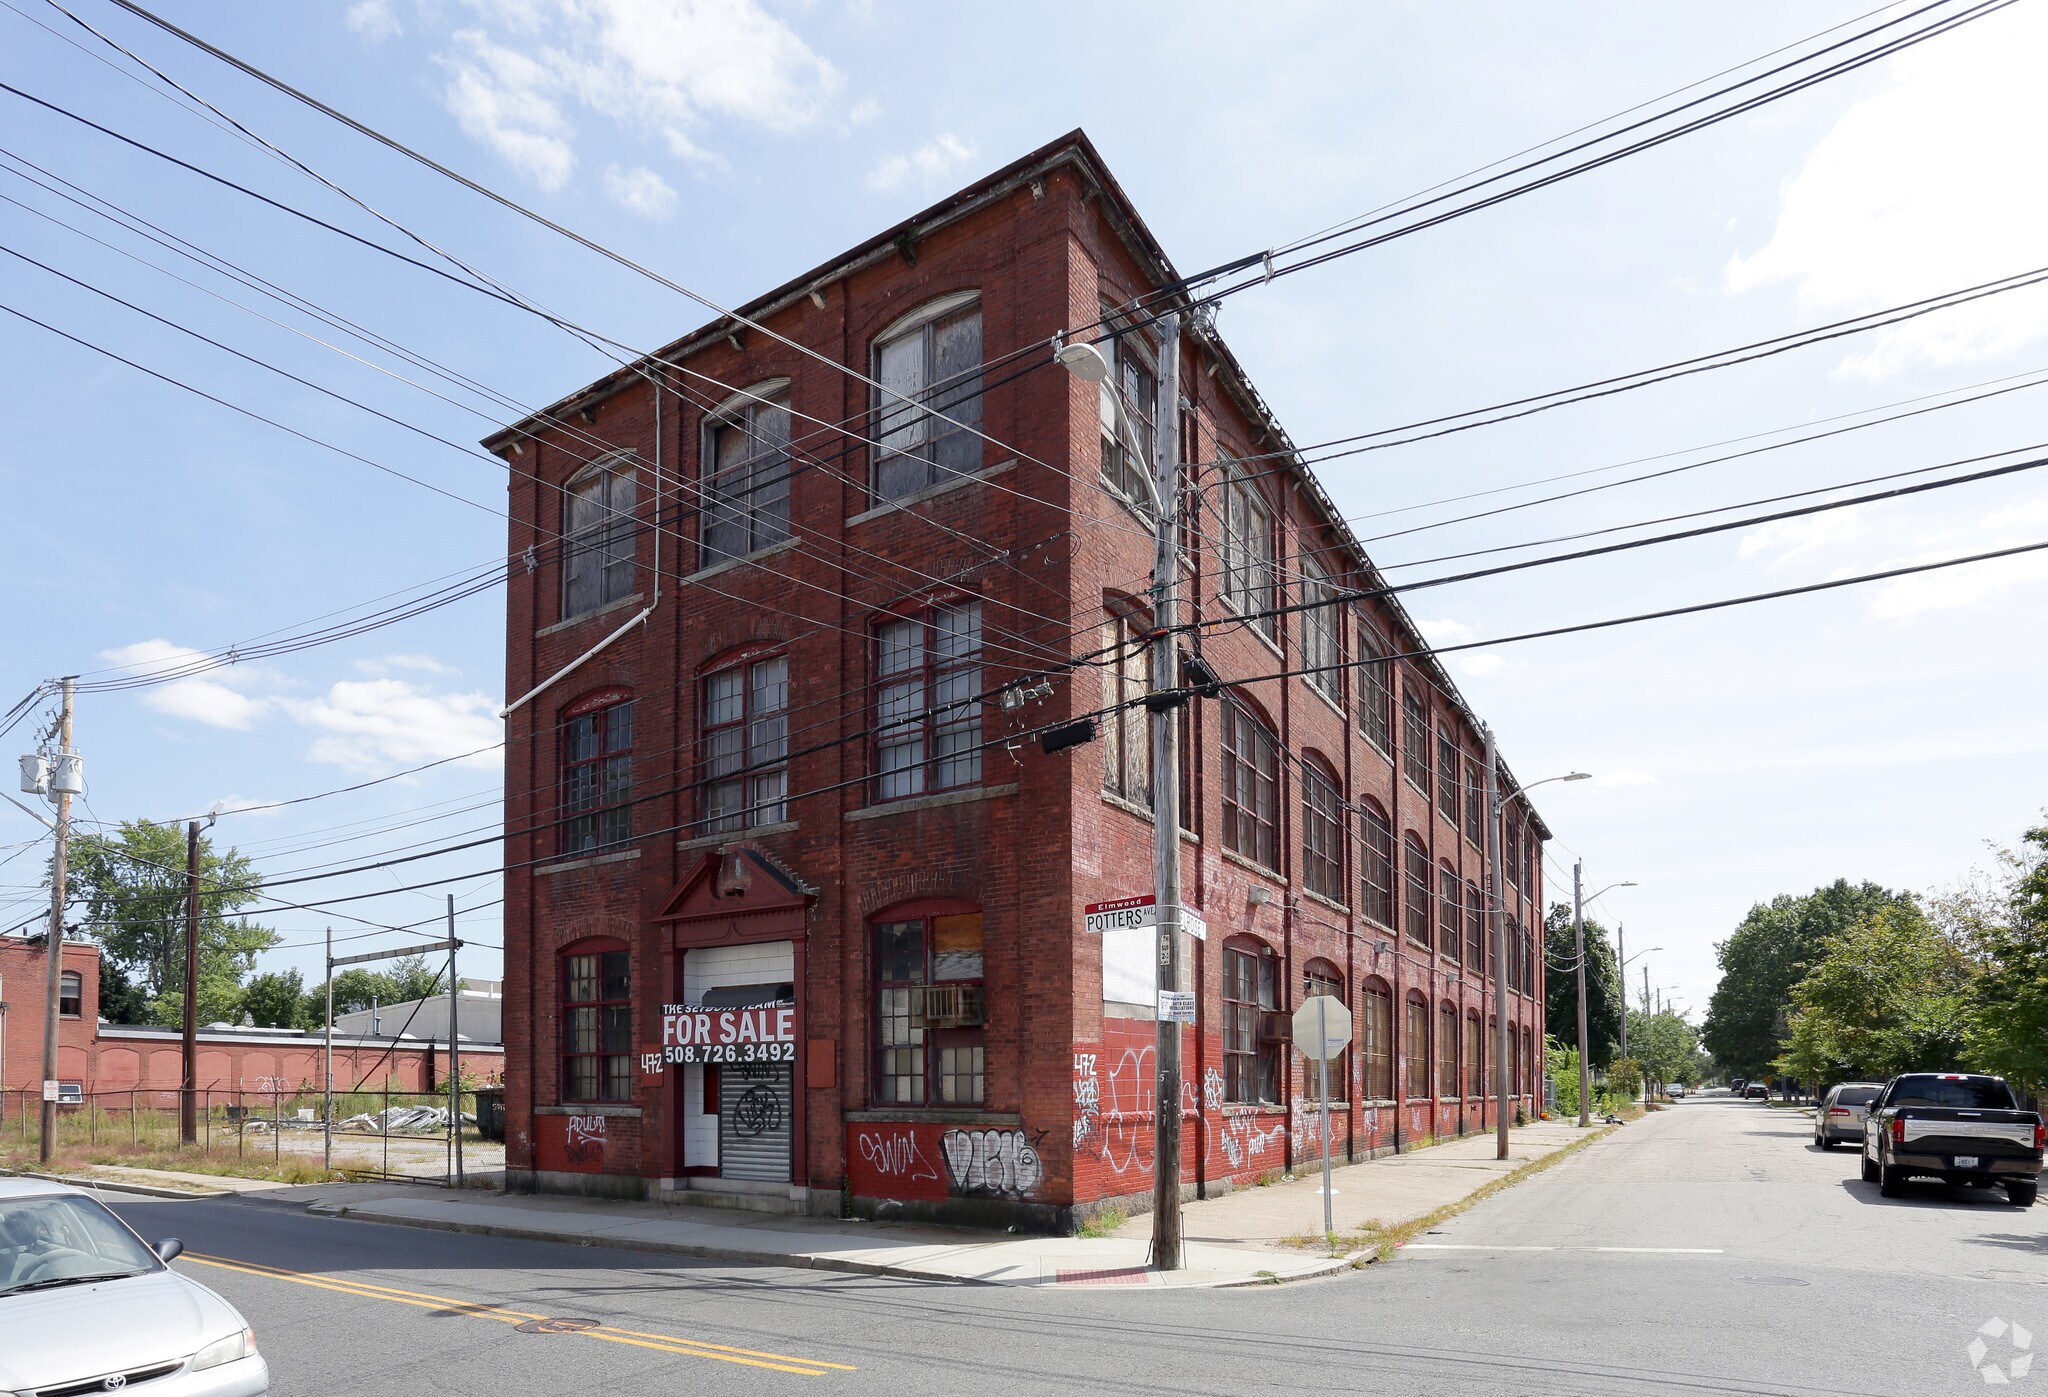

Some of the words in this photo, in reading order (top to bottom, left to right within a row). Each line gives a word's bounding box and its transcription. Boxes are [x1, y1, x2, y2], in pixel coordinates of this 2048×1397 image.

[1098, 899, 1142, 911] Elmwood
[1087, 908, 1143, 932] POTTERS
[1180, 911, 1201, 937] ELROSE
[663, 1004, 685, 1014] THE
[663, 1014, 711, 1045] FOR
[719, 1009, 795, 1043] SALE
[641, 1053, 664, 1075] 472
[665, 1042, 795, 1063] 508.726.3492
[1074, 1053, 1098, 1077] 472
